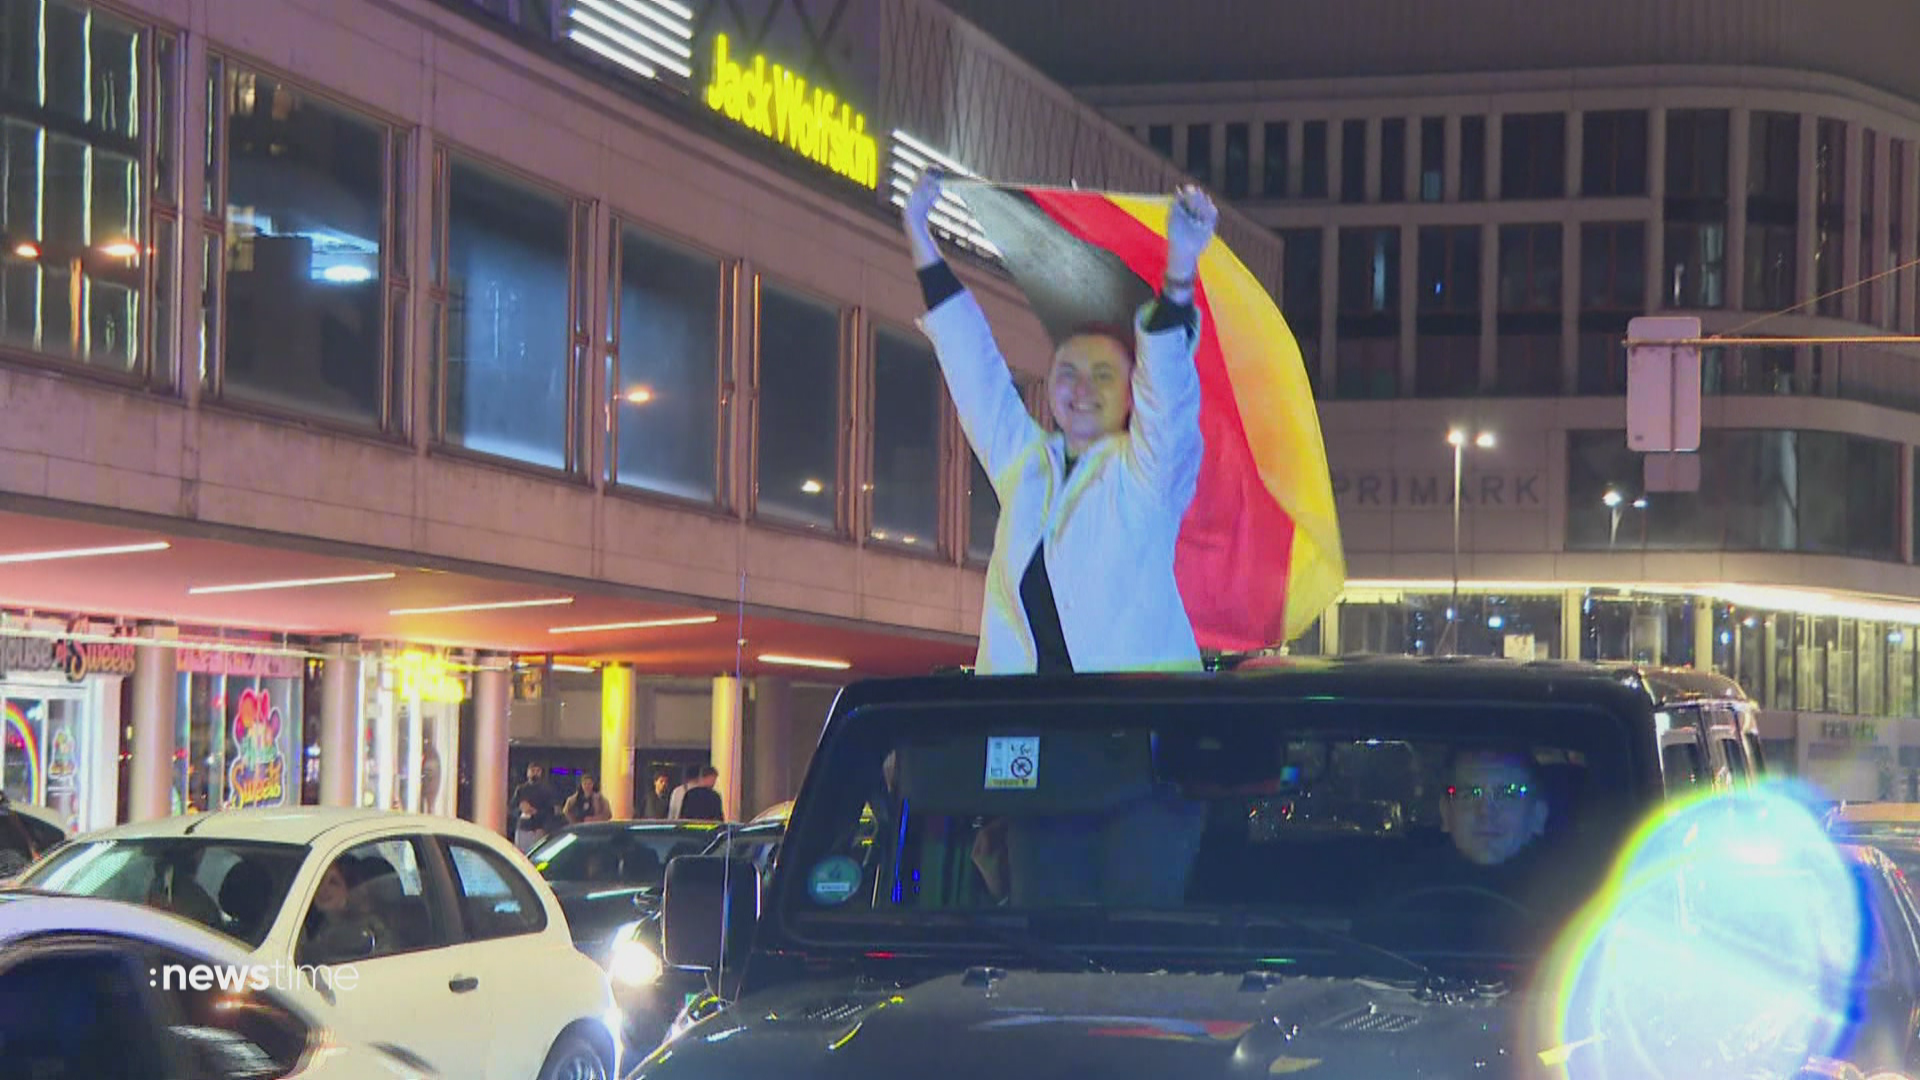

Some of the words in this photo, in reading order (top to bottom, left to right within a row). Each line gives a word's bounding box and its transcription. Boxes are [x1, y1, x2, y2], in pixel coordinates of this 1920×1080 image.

[708, 33, 772, 137] Jack
[772, 63, 877, 190] Wolfskin
[1335, 474, 1540, 506] PRIMARK
[67, 614, 137, 682] Sweets
